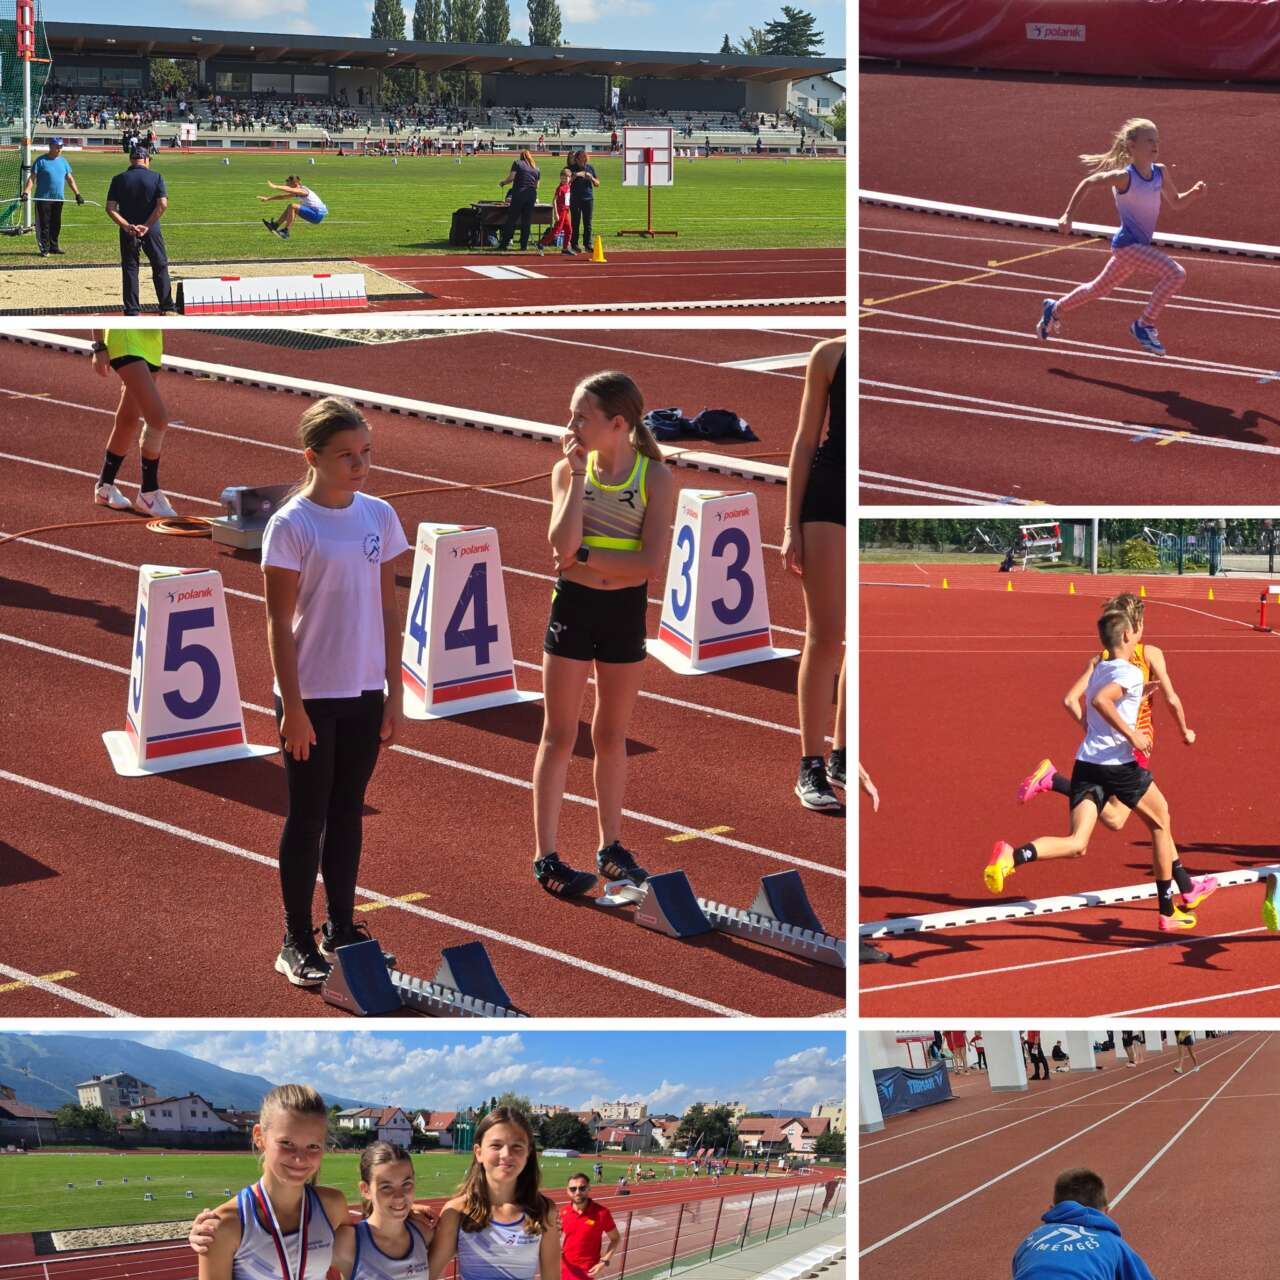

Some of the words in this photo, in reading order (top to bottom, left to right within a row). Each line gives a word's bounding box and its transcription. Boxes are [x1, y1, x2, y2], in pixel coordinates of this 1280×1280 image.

[177, 587, 213, 604] polanik
[460, 542, 491, 559] polanik
[671, 524, 695, 622] 3
[711, 527, 754, 625] 3
[409, 563, 431, 666] 4
[444, 562, 498, 666] 4
[162, 607, 221, 720] 5
